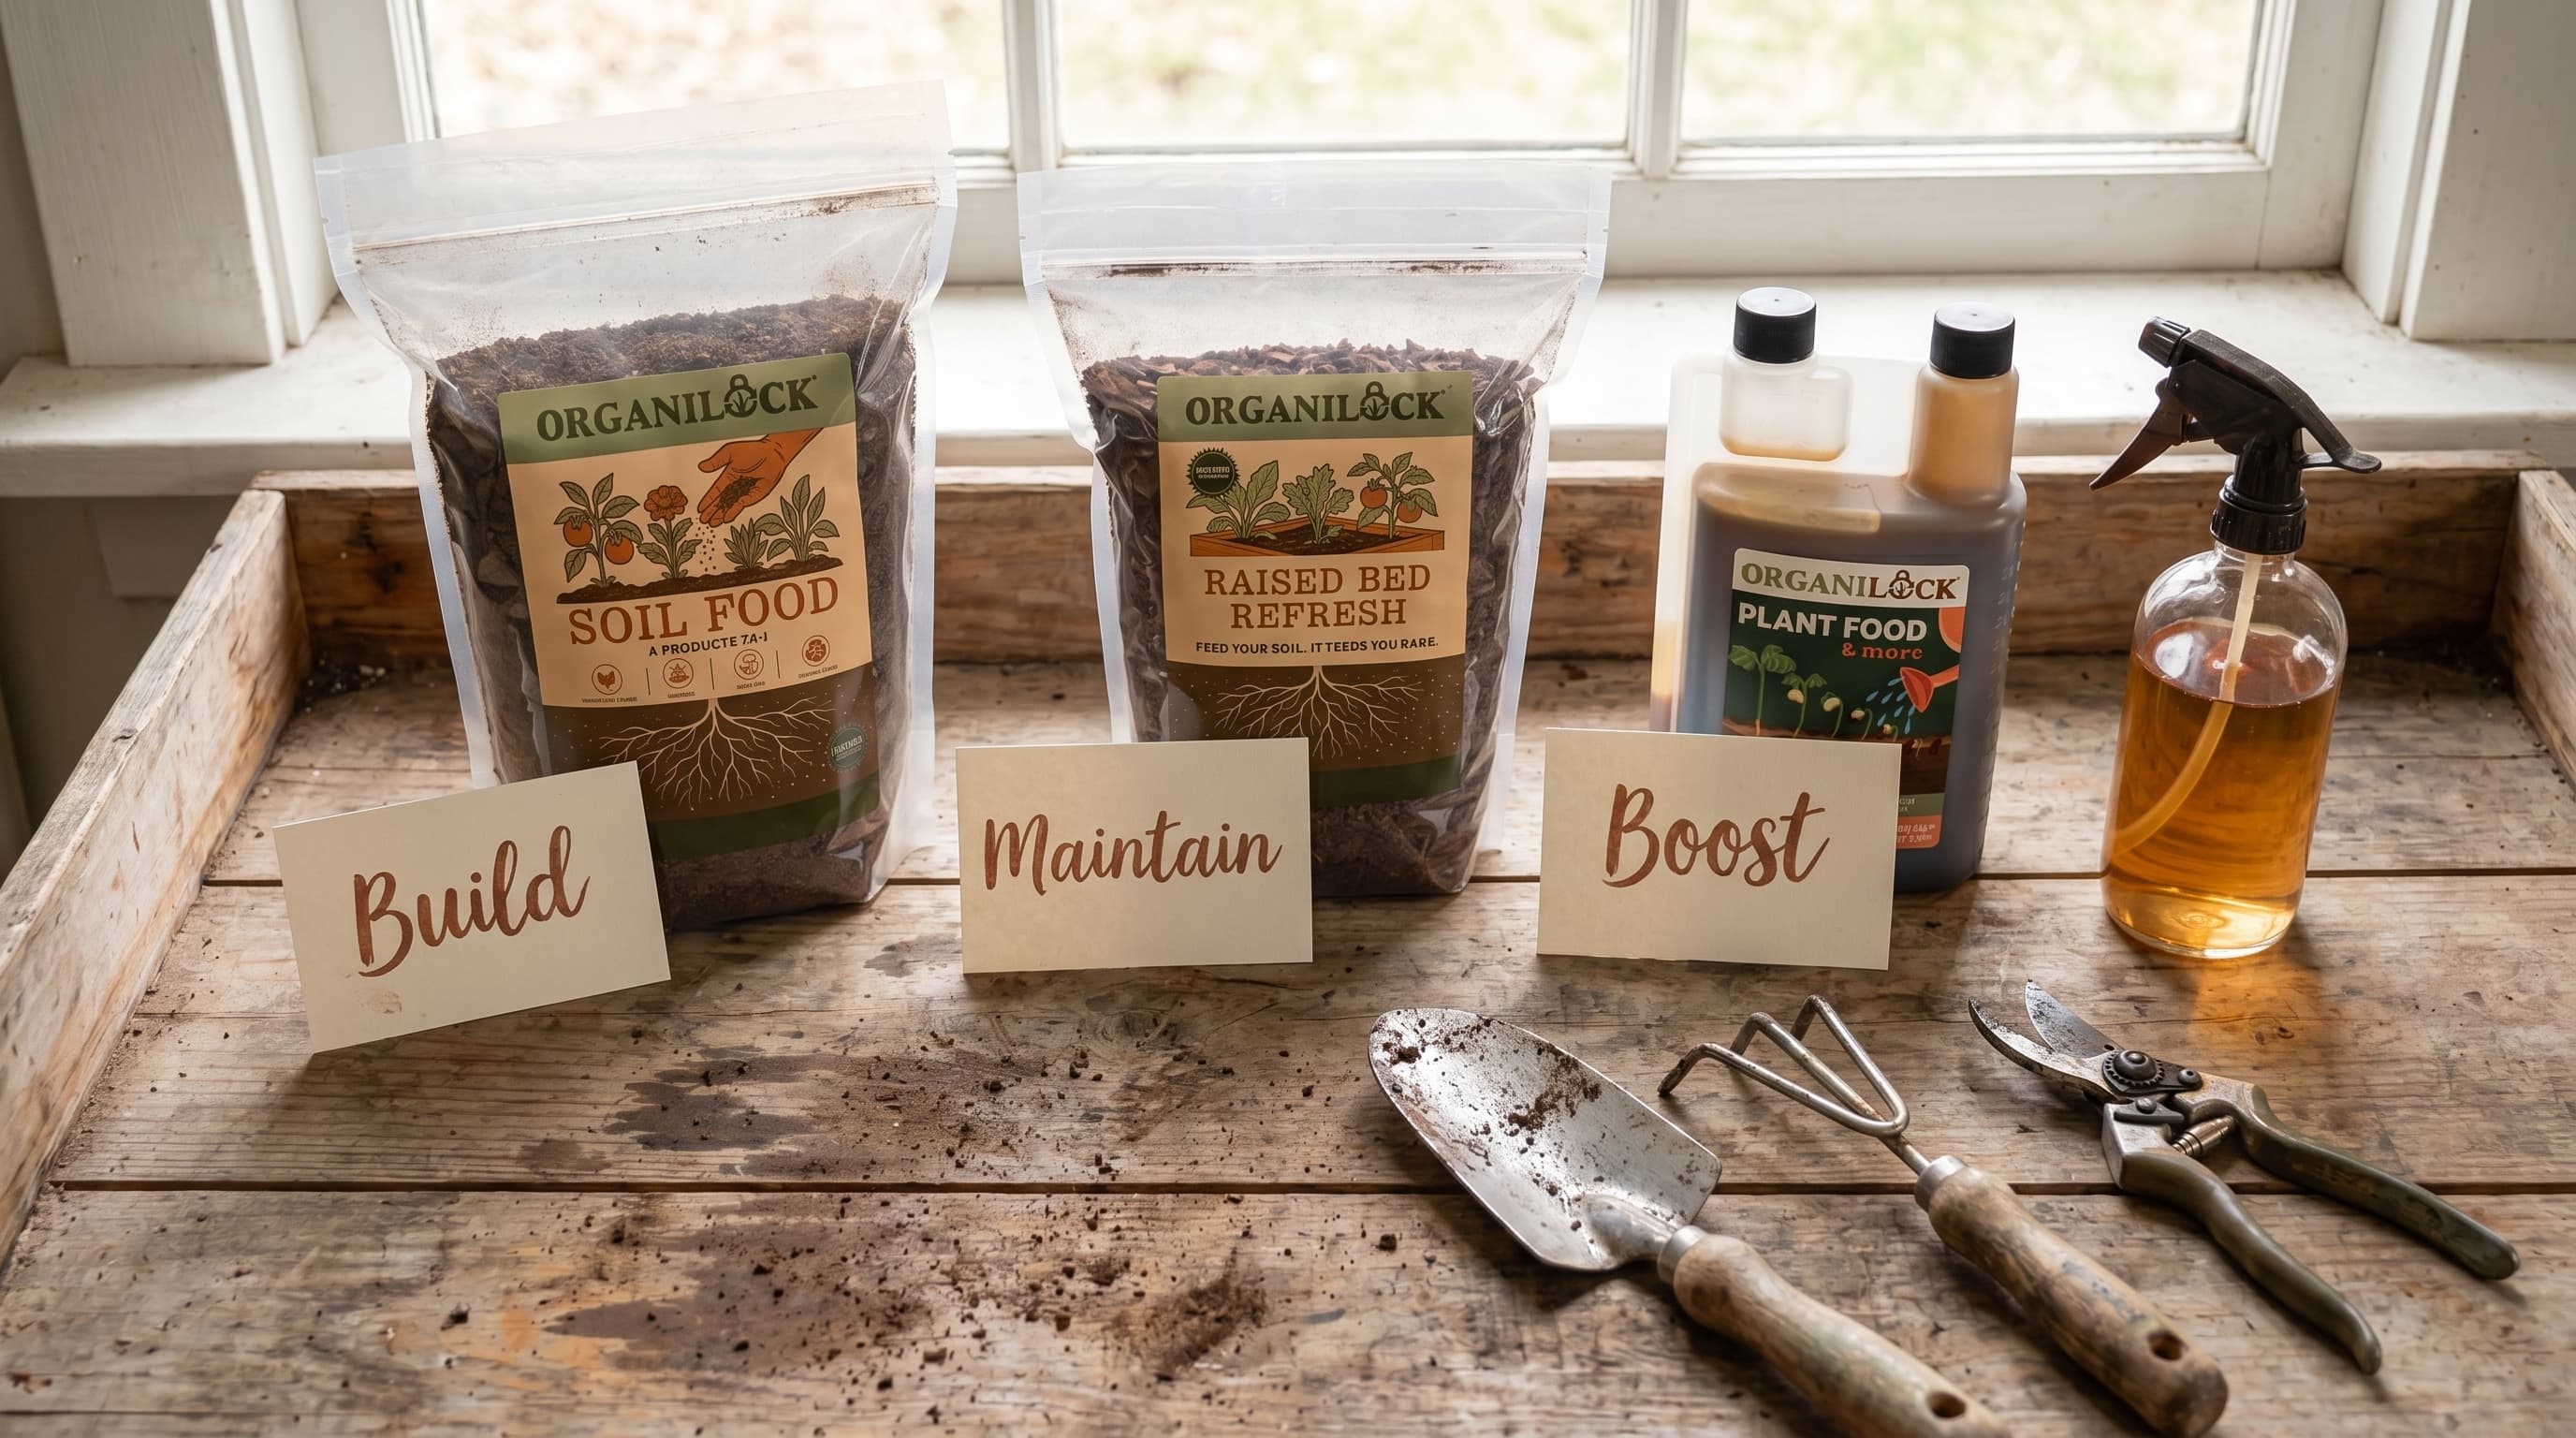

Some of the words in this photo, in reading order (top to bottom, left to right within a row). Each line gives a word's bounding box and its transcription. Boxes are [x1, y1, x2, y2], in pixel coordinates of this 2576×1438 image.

[536, 374, 818, 441] ORGANILOCK
[1185, 381, 1445, 425] ORGANILOCK
[1204, 567, 1343, 595] RAISED
[1357, 565, 1431, 594] BED
[1741, 563, 1958, 601] ORGANILOCK
[568, 601, 688, 645] SOIL
[703, 577, 839, 633] FOOD
[1230, 599, 1407, 629] REFRESH
[1737, 602, 1837, 638] PLANT
[1842, 616, 1927, 642] FOOD
[649, 646, 658, 656] A
[662, 636, 738, 655] PRODUCTE
[1195, 641, 1229, 653] FEED
[1232, 643, 1268, 654] YOUR
[1271, 643, 1308, 653] SOIL.
[1310, 642, 1323, 653] IT
[1325, 640, 1368, 653] TEEDS
[1370, 639, 1399, 652] YOU
[1400, 637, 1439, 650] RARE.
[1841, 642, 1856, 657] &
[1861, 646, 1924, 660] more
[984, 810, 1283, 897] Maintain
[1602, 783, 1831, 888] Boost
[354, 825, 591, 977] Build
